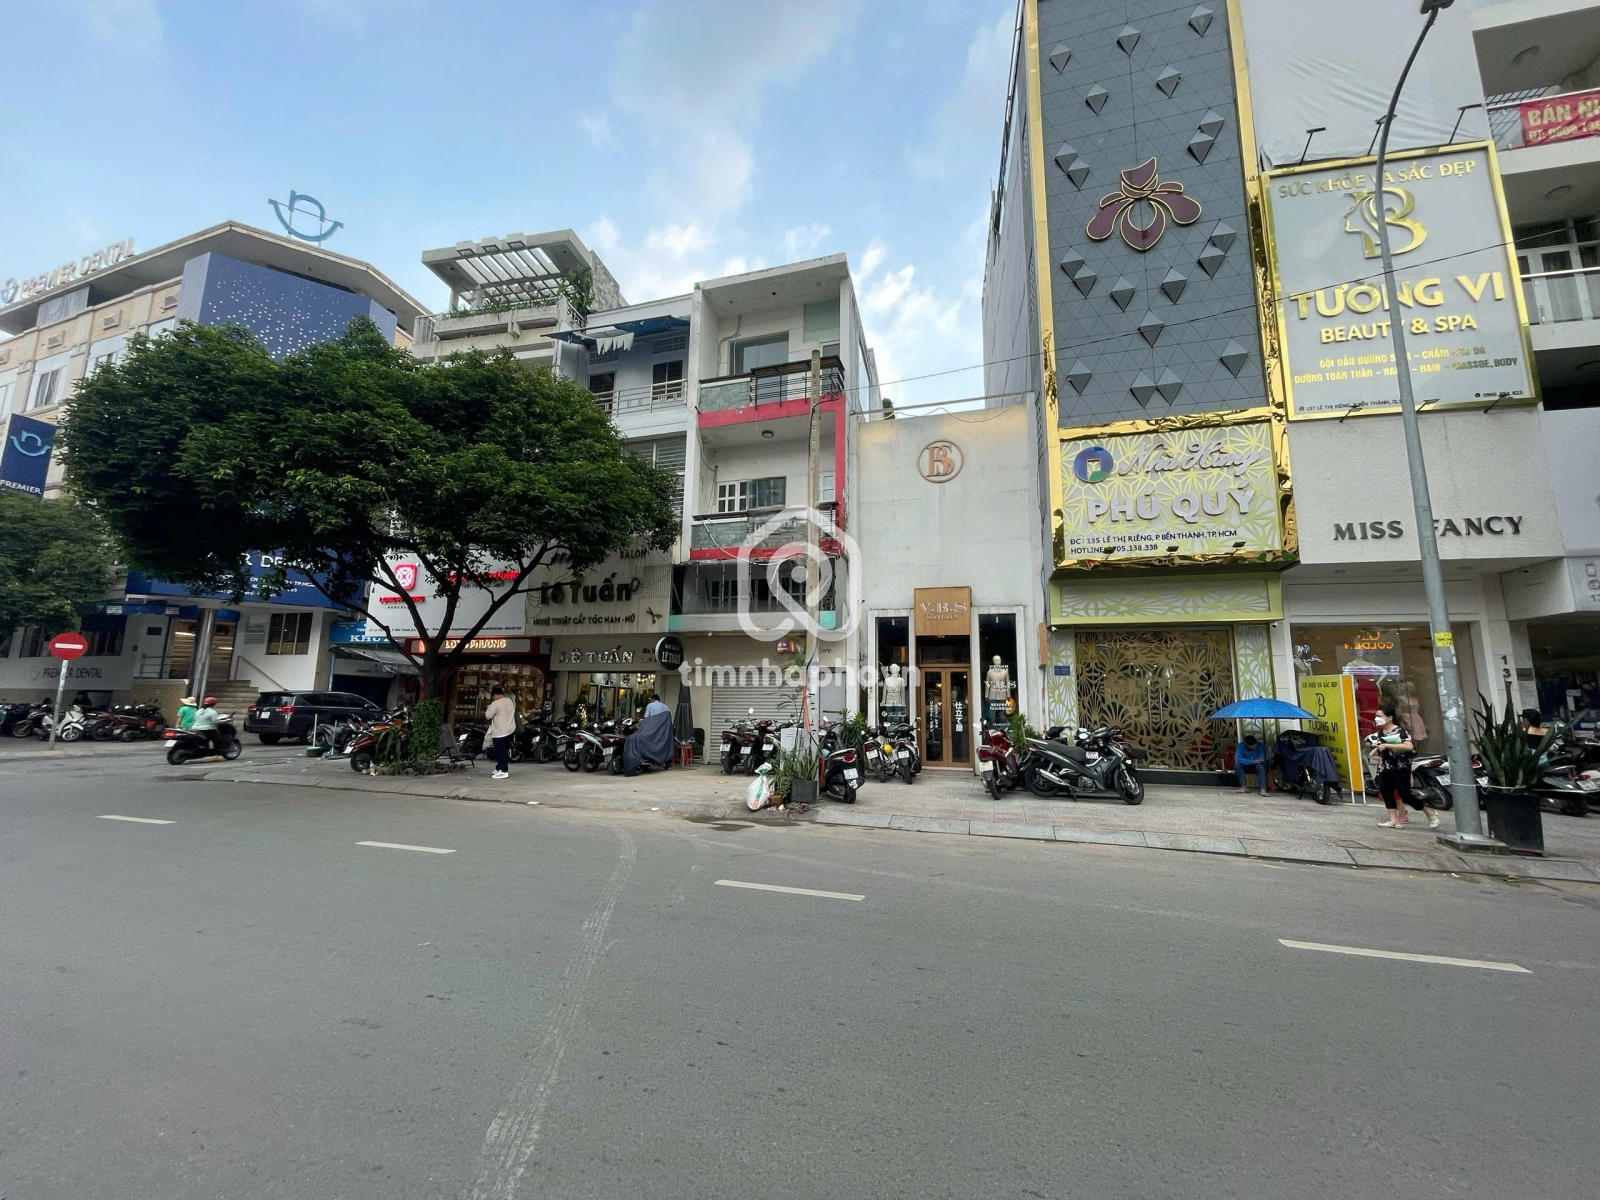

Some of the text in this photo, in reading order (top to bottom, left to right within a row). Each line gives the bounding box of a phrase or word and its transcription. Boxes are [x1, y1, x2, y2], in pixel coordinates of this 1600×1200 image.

[1527, 103, 1572, 127] BÁN
[1278, 180, 1311, 199] SỨC
[1398, 161, 1434, 181] SẮC
[1439, 159, 1476, 178] ĐẸP
[1457, 271, 1506, 303] VI
[1320, 313, 1479, 345] BEAUT & SPA
[1420, 362, 1441, 374] HAIR
[1494, 357, 1518, 368] BODY
[0, 479, 42, 495] PREMIER
[1087, 481, 1256, 523] PHÚ QUÝ
[1102, 535, 1112, 543] LÊ
[1113, 535, 1127, 544] THỊ
[1219, 529, 1237, 538] HCM
[1333, 520, 1404, 541] MISS
[1110, 543, 1159, 553] 705.138.338
[918, 601, 968, 614] V.B.S
[573, 613, 586, 625] CẮT
[588, 614, 603, 624] TÓC
[604, 616, 620, 624] NAM
